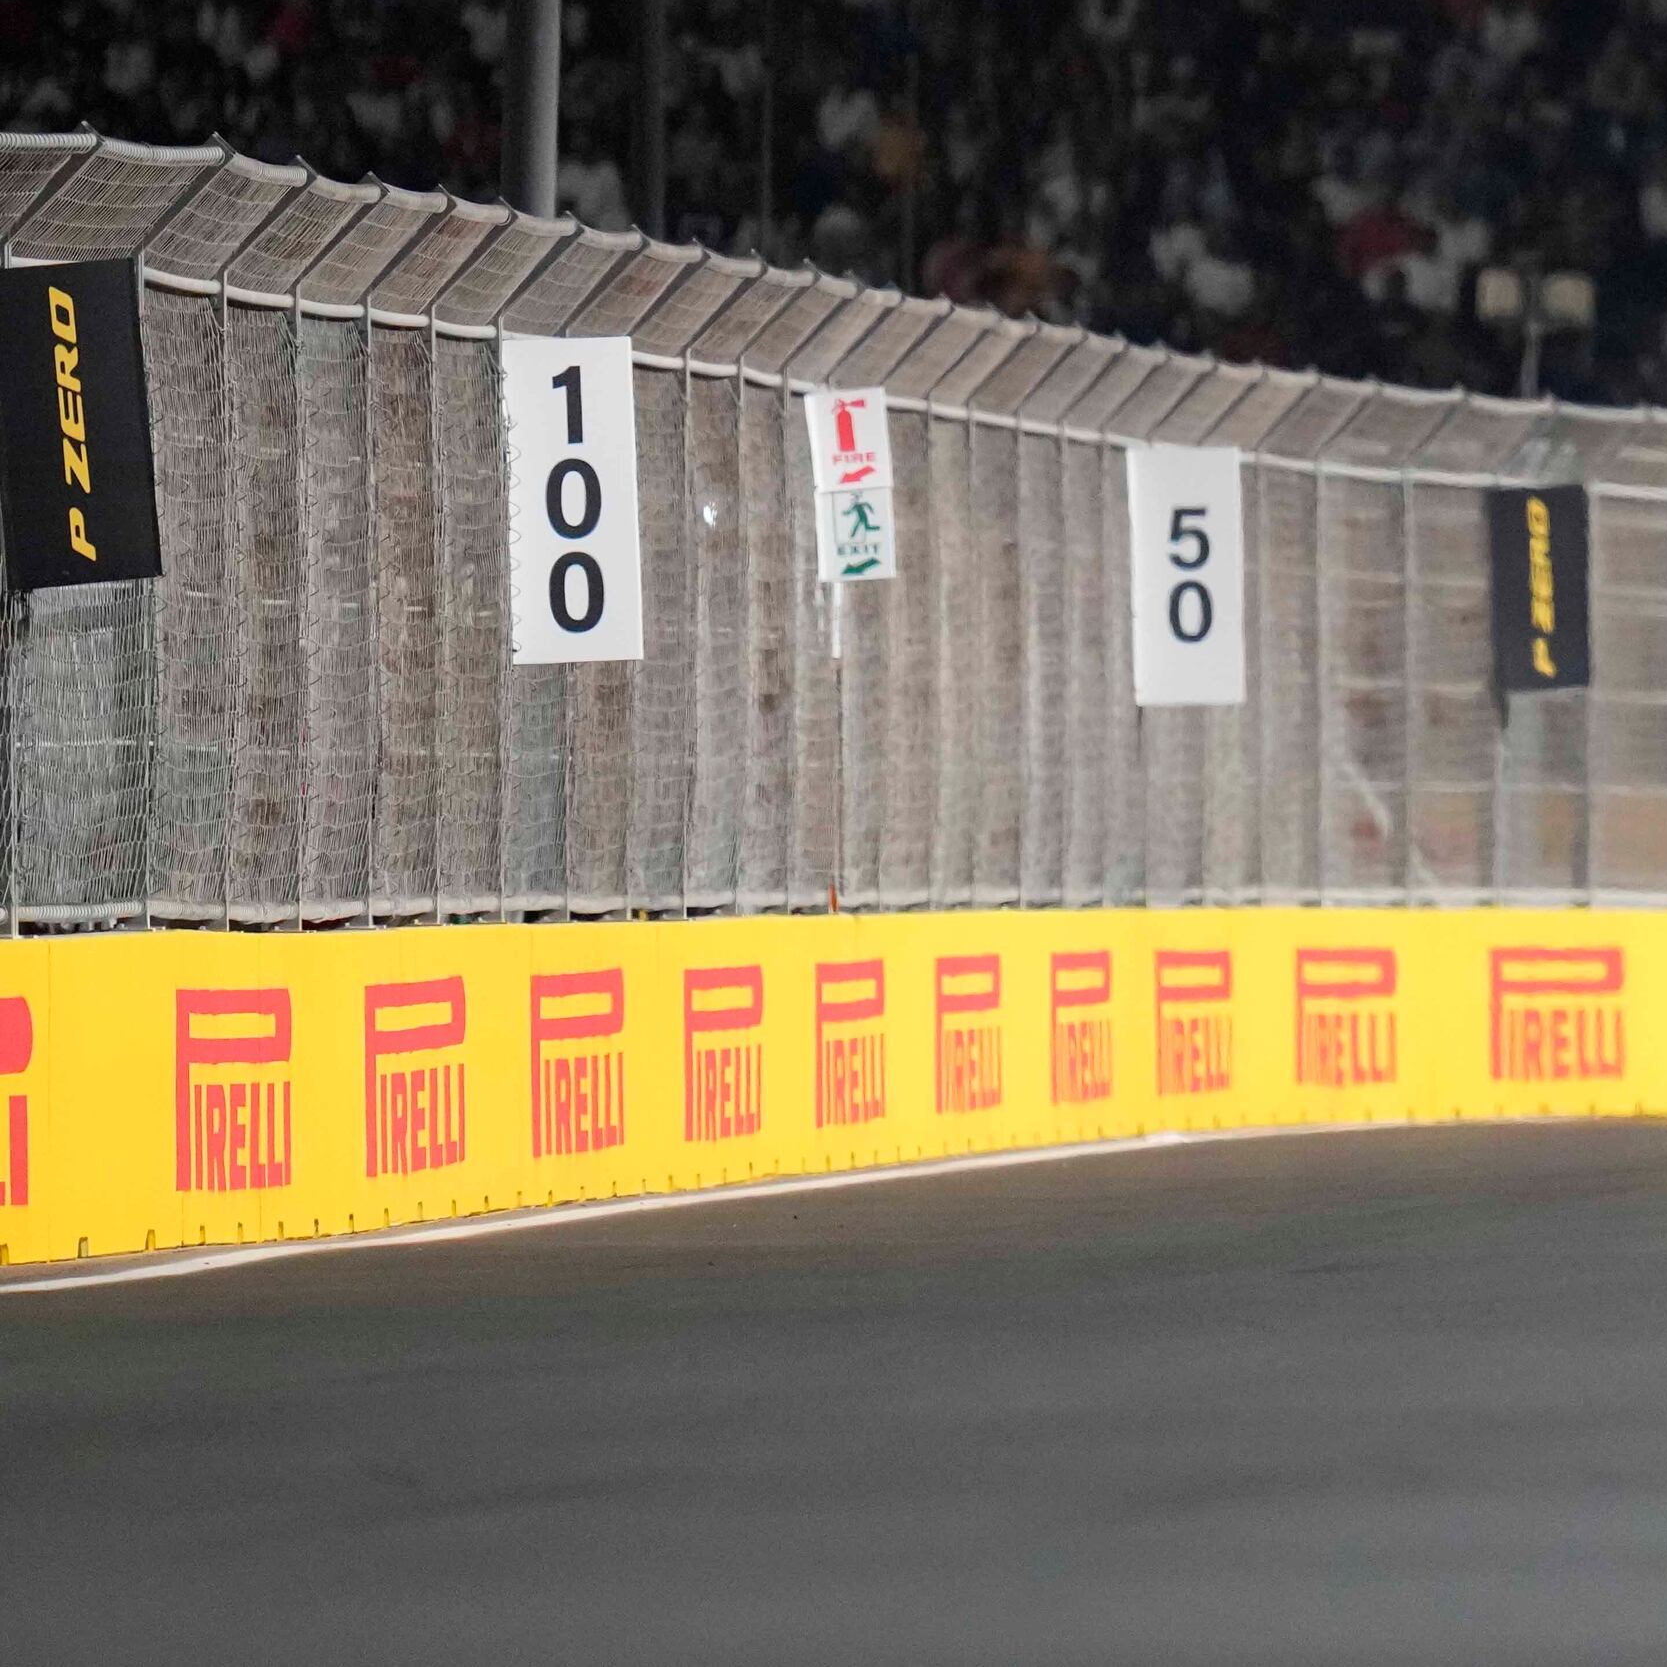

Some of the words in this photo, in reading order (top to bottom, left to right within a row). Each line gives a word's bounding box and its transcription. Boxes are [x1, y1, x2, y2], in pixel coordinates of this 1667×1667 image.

[49, 286, 92, 495] ZERO
[833, 452, 876, 465] FIRE
[69, 507, 97, 563] P
[545, 365, 605, 633] 100
[837, 543, 881, 556] EXIT
[1168, 507, 1213, 642] 50
[175, 987, 292, 1193] PIRELLI
[364, 975, 466, 1179] PIRELLI
[530, 967, 625, 1160] PIRELLI
[684, 964, 763, 1142] PIRELLI
[815, 958, 885, 1128] PIRELLI
[1295, 948, 1398, 1088] PIRELLI
[1489, 947, 1625, 1081] PIRELLI
